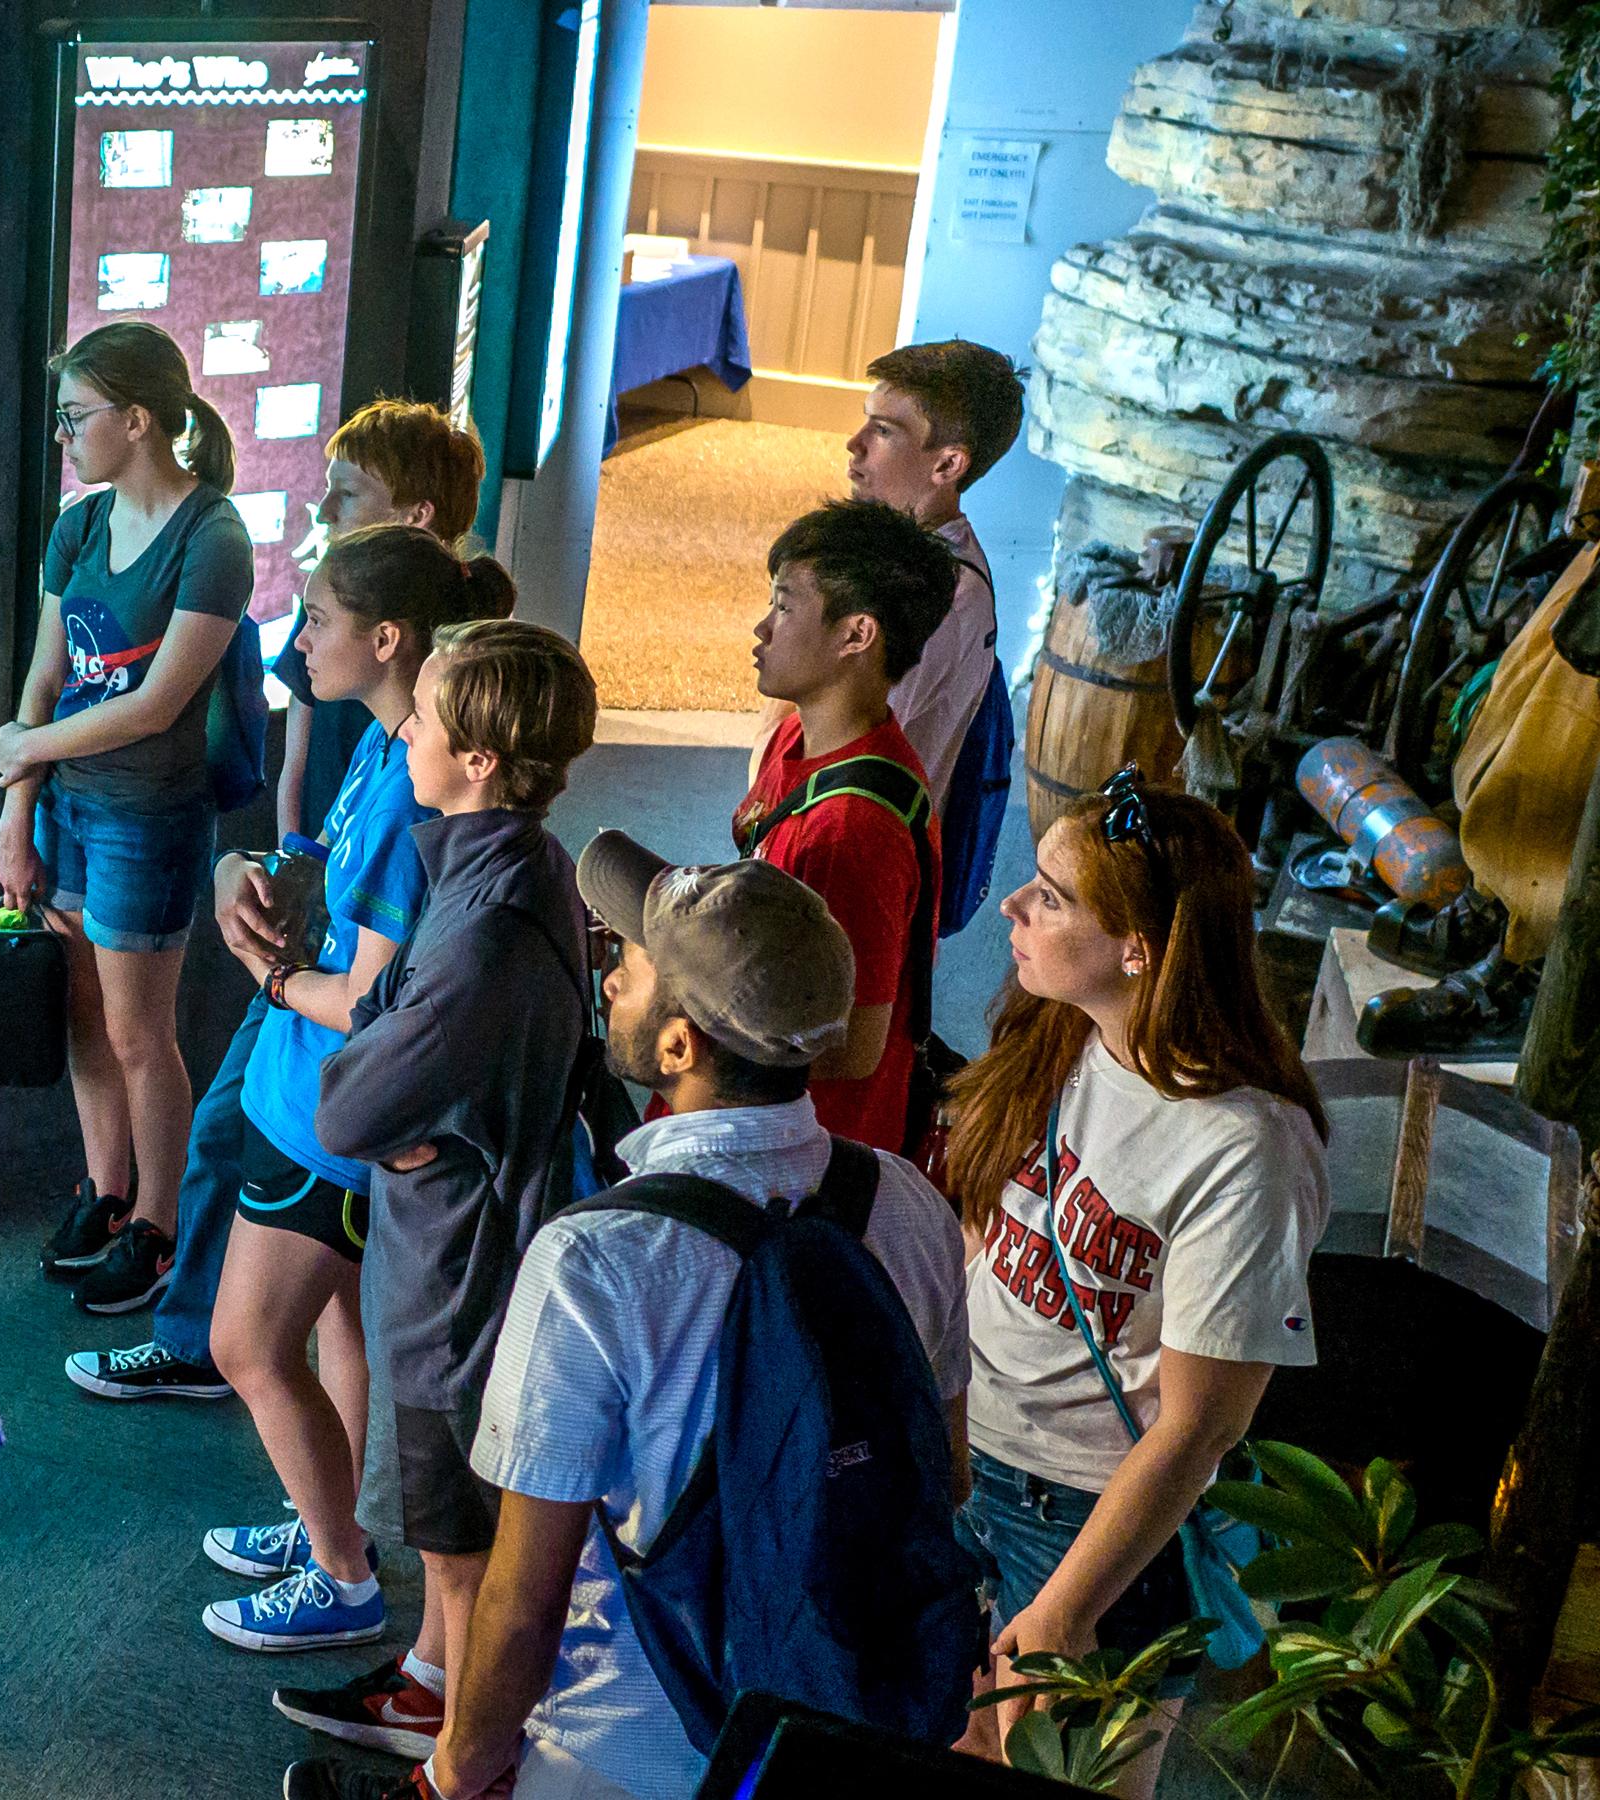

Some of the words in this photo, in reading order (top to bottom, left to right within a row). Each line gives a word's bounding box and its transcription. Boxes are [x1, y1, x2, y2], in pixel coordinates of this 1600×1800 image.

[85, 55, 191, 89] Who's
[193, 55, 269, 89] Who
[968, 168, 987, 177] EXIT
[1058, 1176, 1163, 1292] STATE
